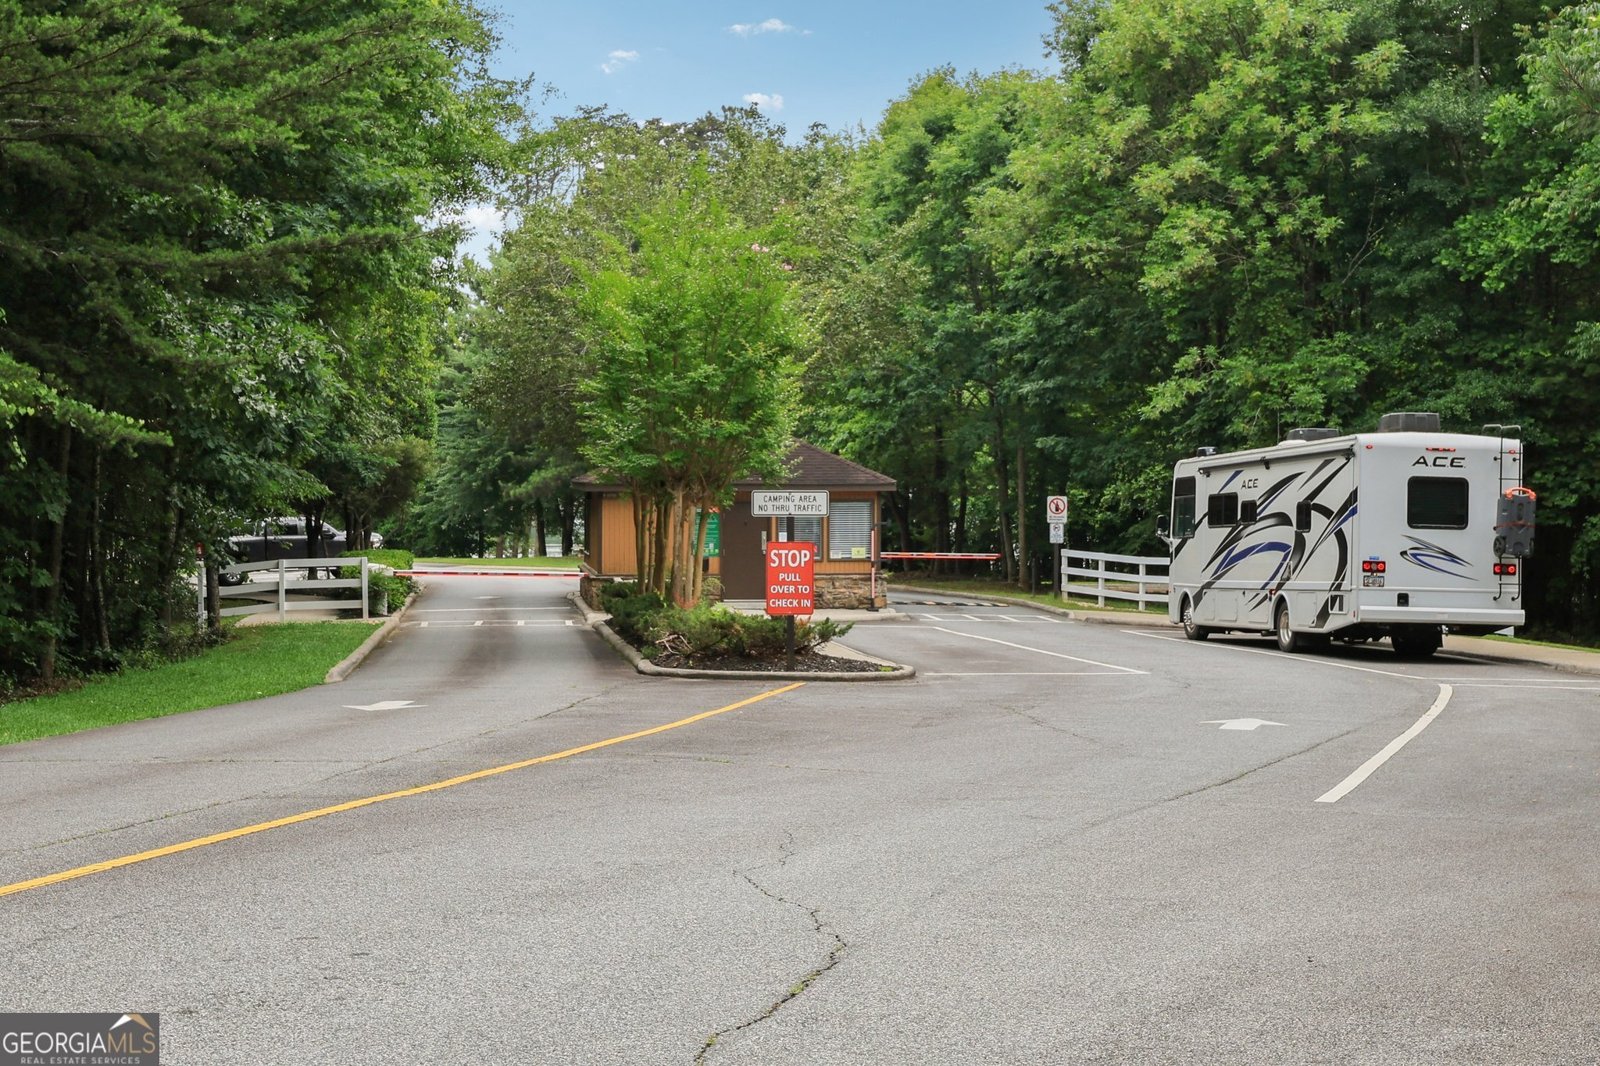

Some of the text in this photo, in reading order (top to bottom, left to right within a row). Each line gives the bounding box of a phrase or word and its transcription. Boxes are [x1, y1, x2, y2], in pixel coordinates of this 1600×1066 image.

[763, 495, 817, 503] CAMPING AREA
[758, 504, 822, 512] NO THRU TRAFFIC
[770, 549, 810, 568] STOP
[779, 573, 801, 581] PULL
[770, 585, 810, 594] OVER TO
[769, 599, 811, 608] CHECK IN
